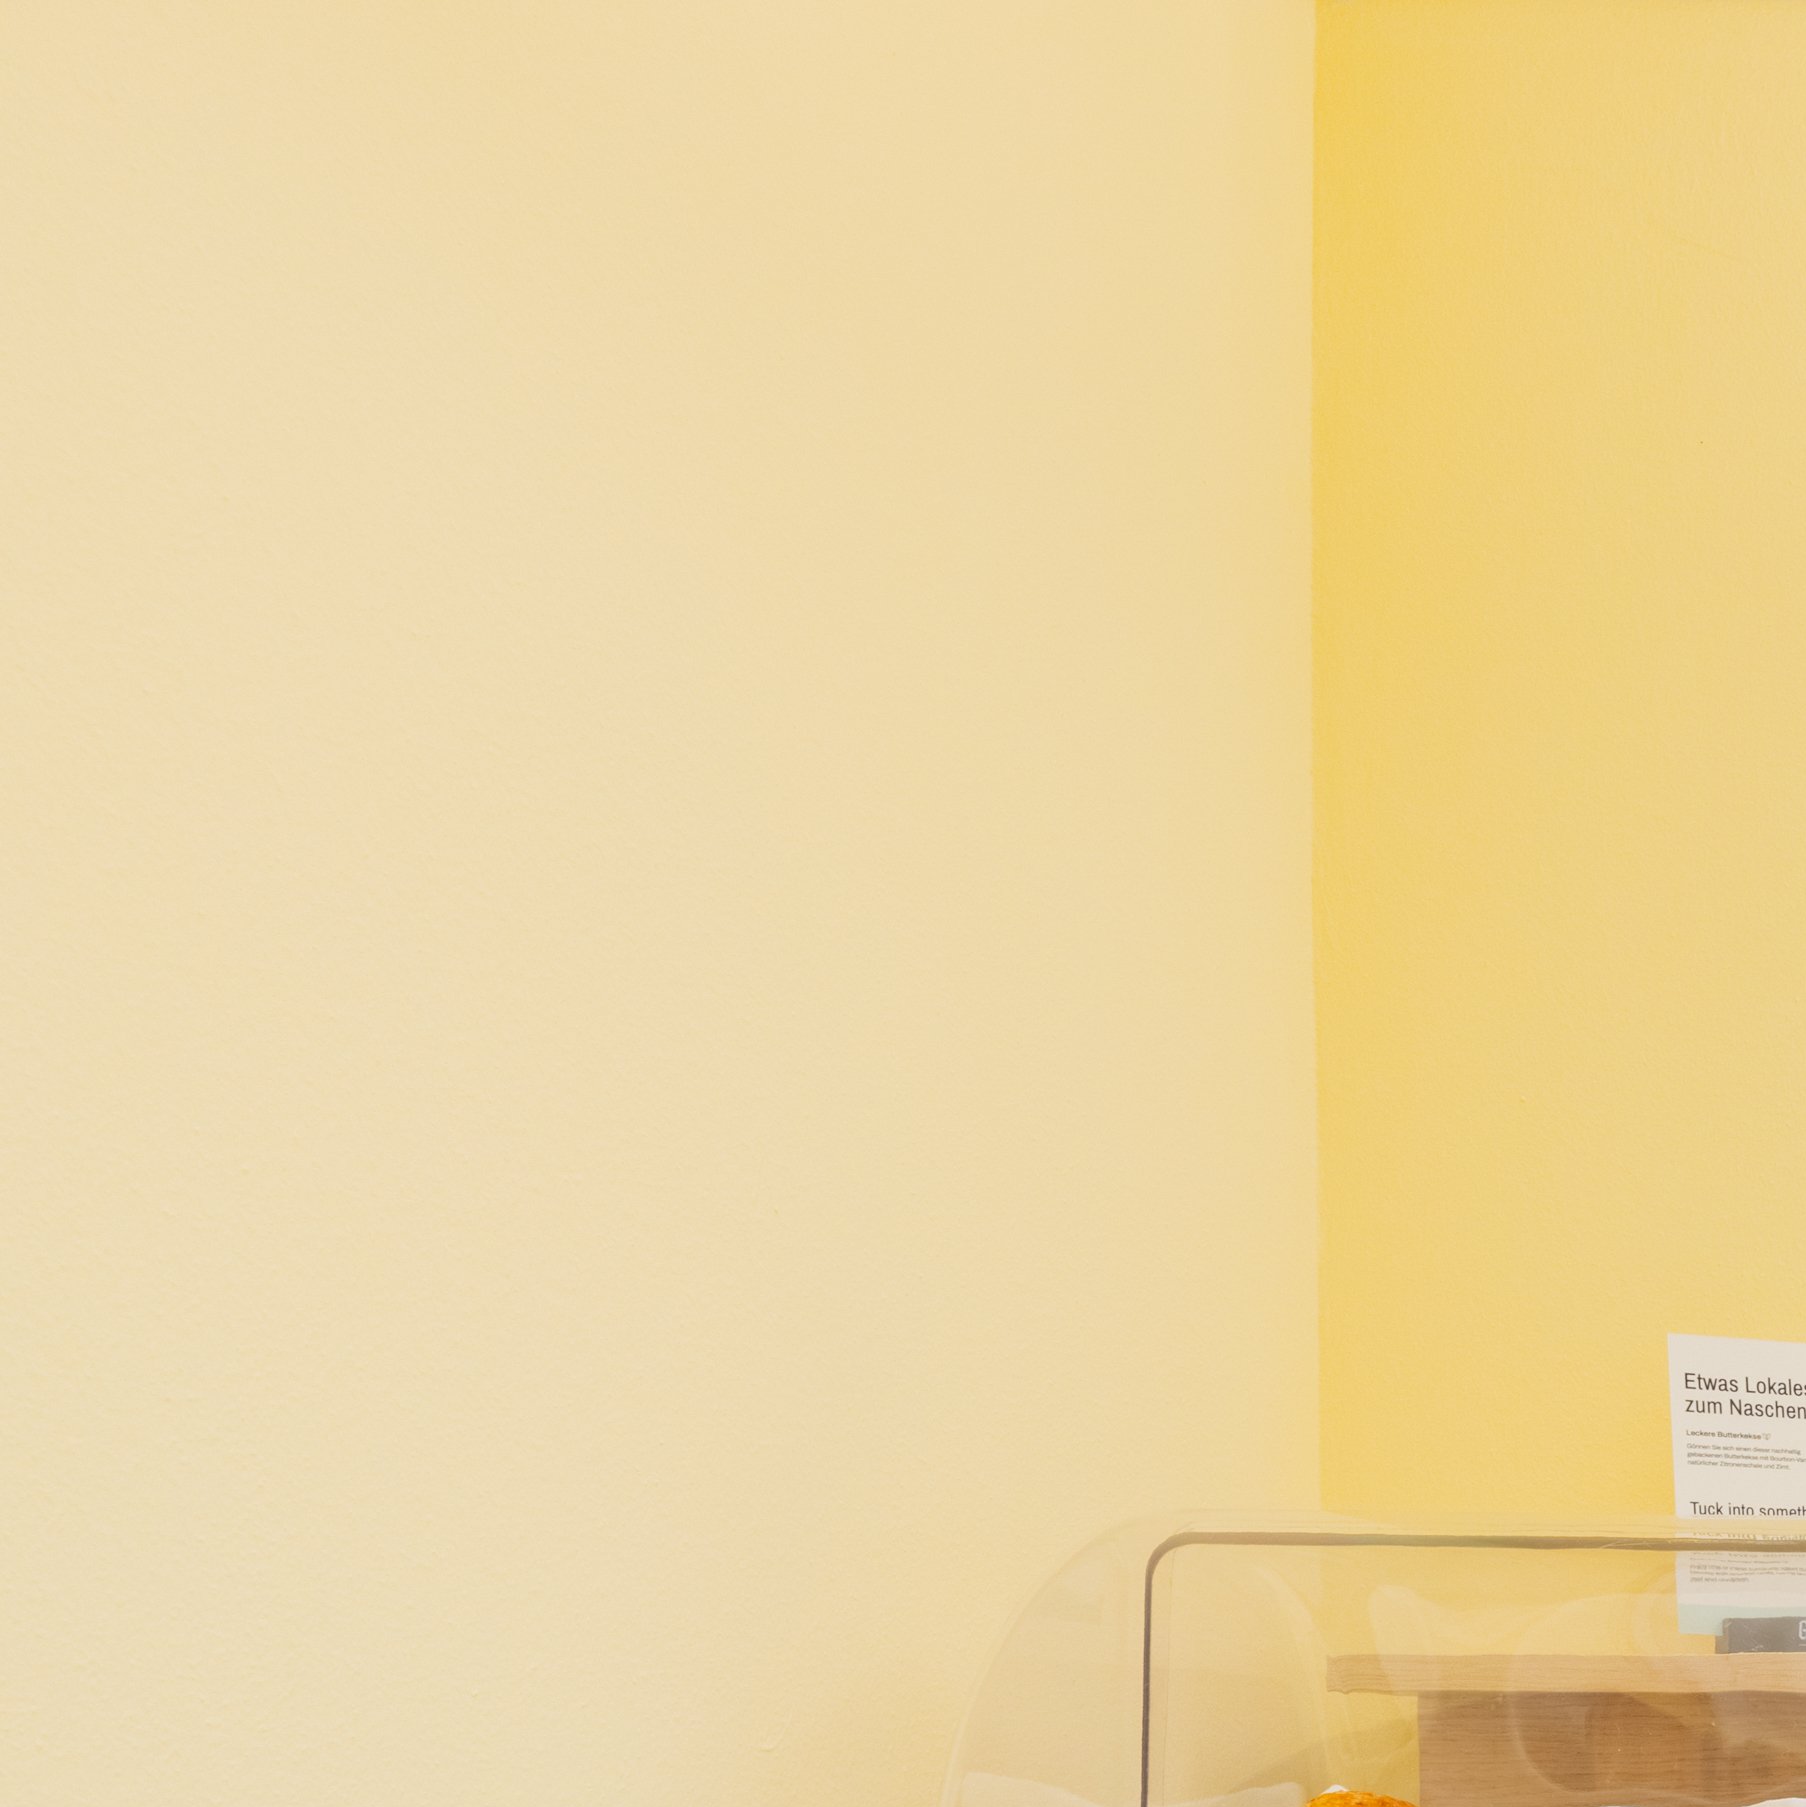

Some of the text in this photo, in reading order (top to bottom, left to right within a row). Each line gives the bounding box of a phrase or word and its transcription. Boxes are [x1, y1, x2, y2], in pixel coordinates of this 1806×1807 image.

[1684, 1372, 1739, 1393] Etwas
[1685, 1399, 1723, 1415] zum
[1690, 1501, 1723, 1516] Tuck
[1728, 1502, 1755, 1516] into
